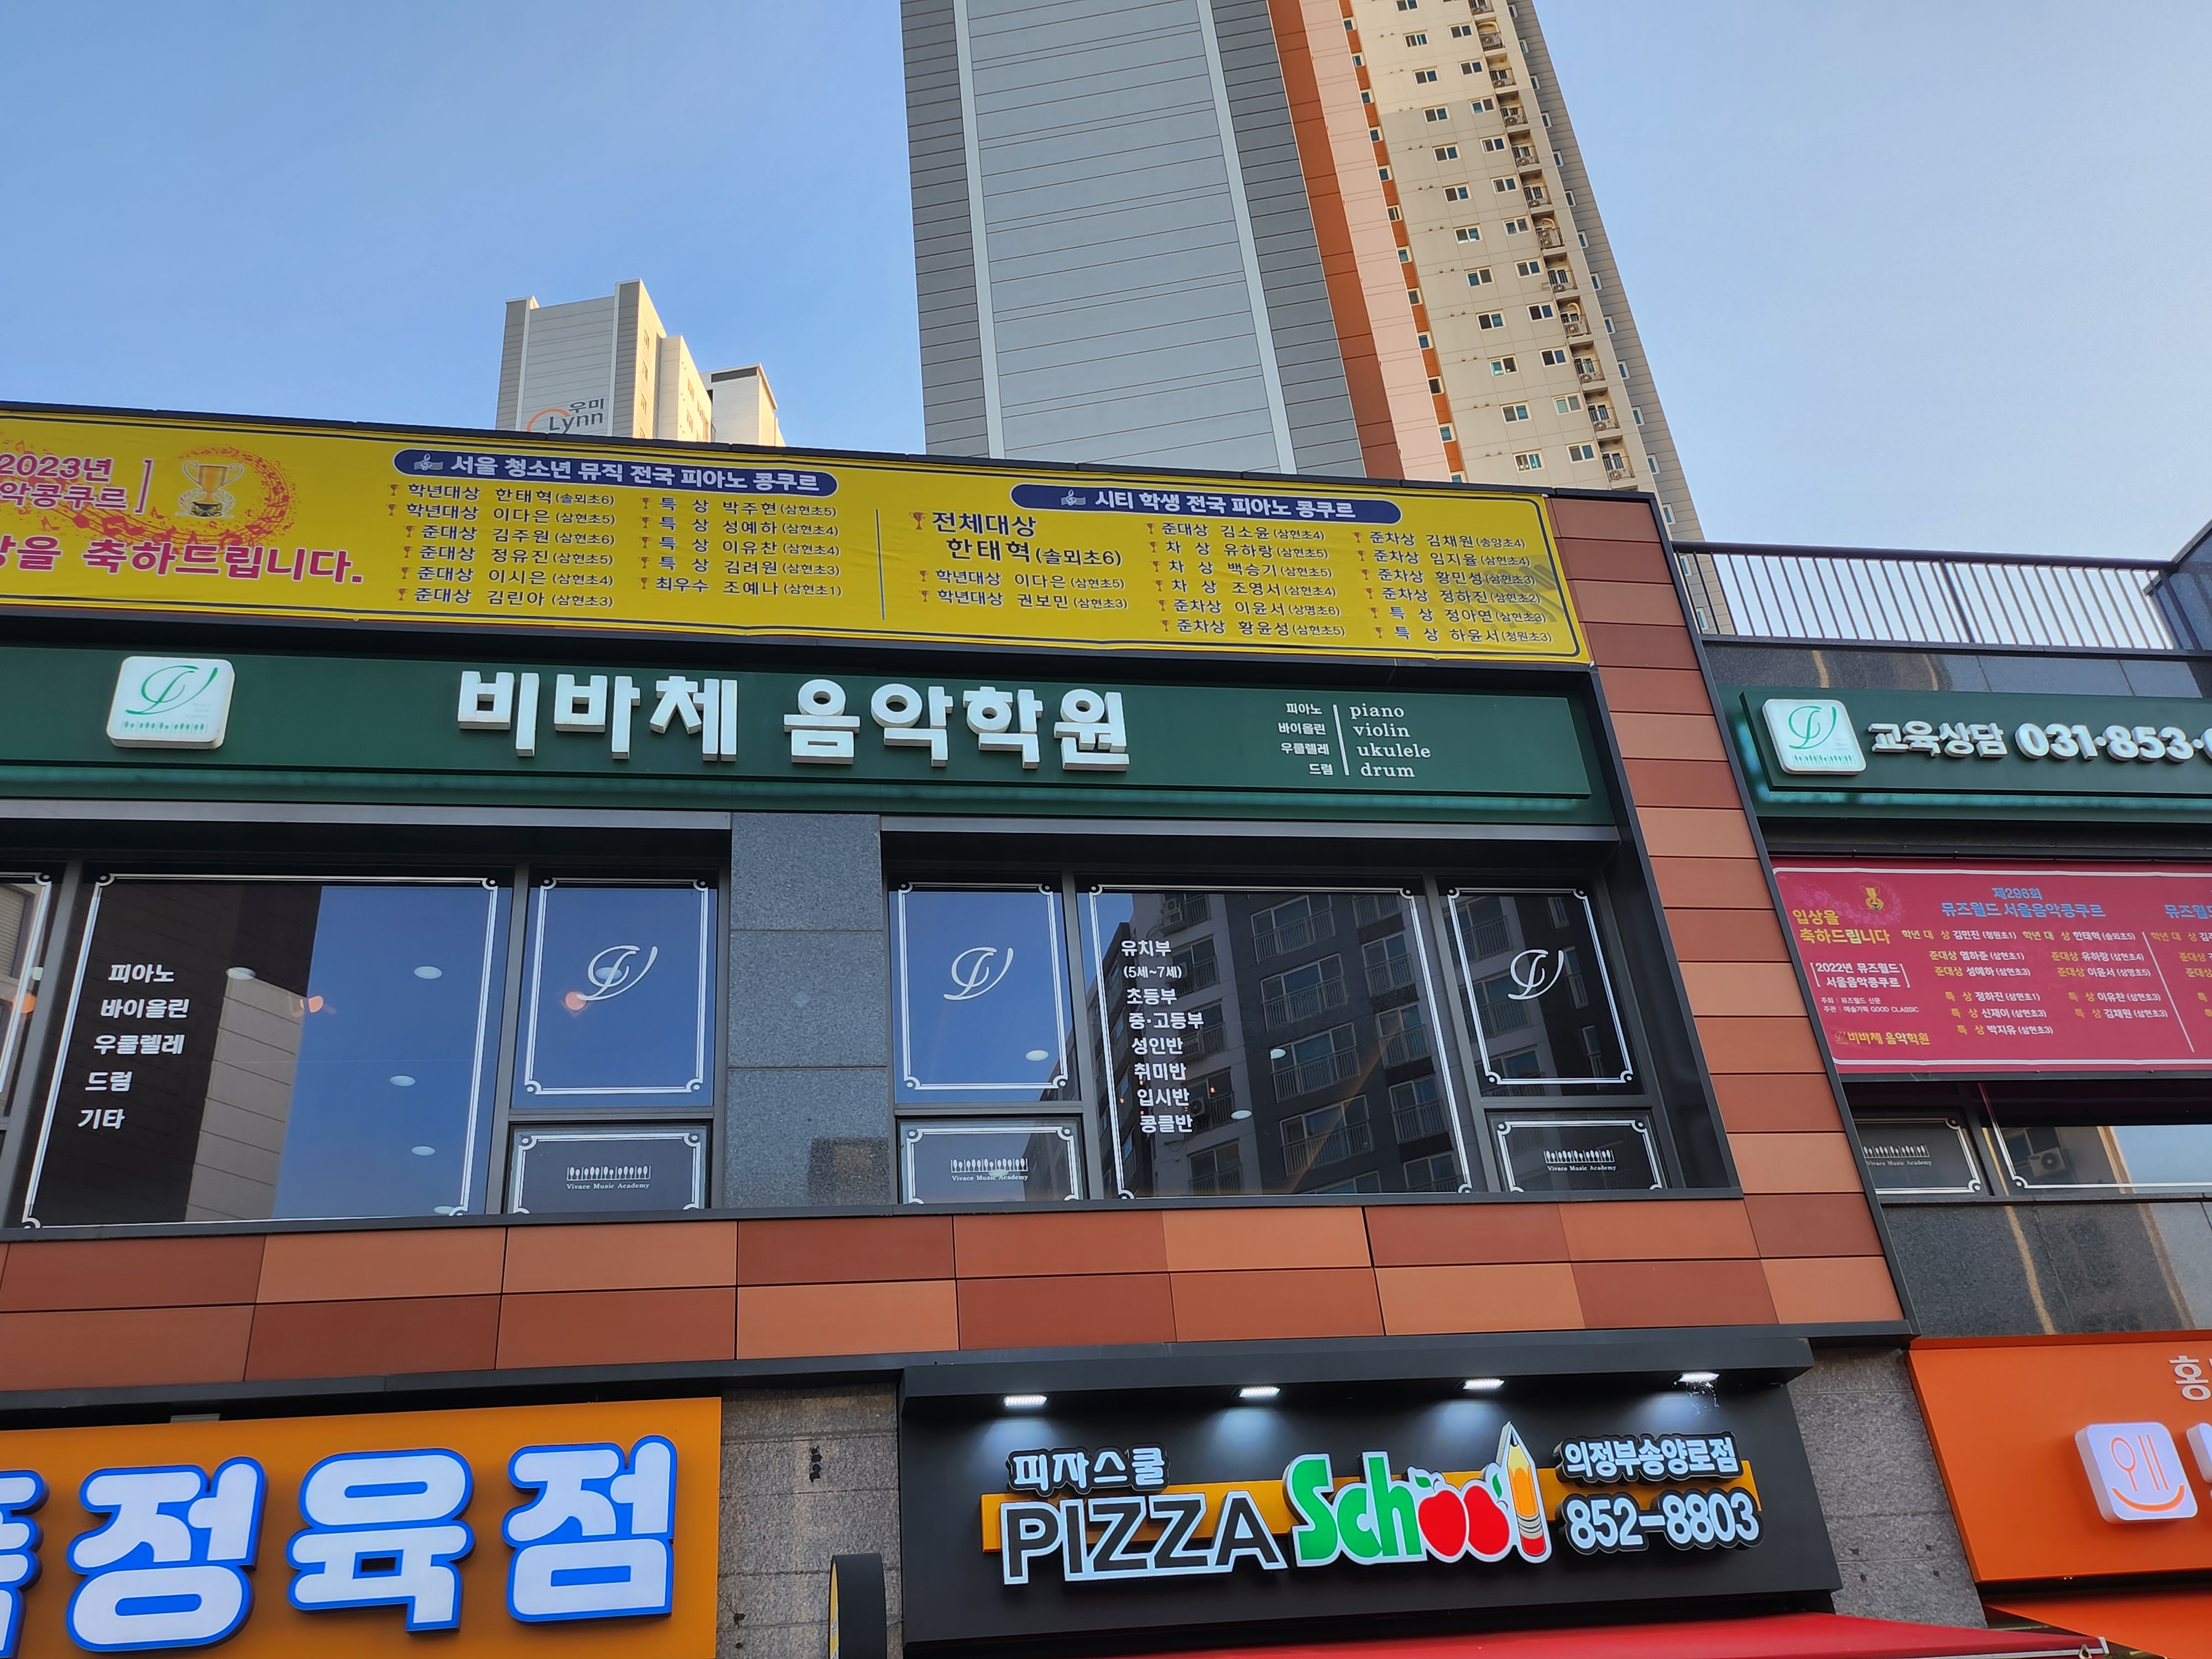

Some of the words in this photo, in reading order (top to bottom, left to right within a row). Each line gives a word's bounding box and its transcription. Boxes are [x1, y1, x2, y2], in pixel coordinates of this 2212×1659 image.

[569, 398, 604, 413] 우미
[550, 413, 603, 434] Lynn
[0, 453, 112, 482] 2023년
[451, 455, 498, 475] 서울
[504, 457, 571, 479] 청소년
[578, 462, 623, 482] 뮤직
[630, 466, 675, 485] 전국
[681, 469, 748, 489] 피아노
[753, 473, 820, 492] 콩쿠르
[408, 483, 481, 501] 학년대상
[495, 488, 552, 505] 한태혁
[406, 503, 479, 520] 학년대상
[493, 508, 550, 524] 이다은
[1095, 491, 1134, 509] 시티
[1139, 492, 1180, 512] 학생
[1186, 495, 1227, 514] 전국
[1231, 498, 1292, 516] 피아노
[1295, 501, 1356, 519] 콩쿠르
[932, 512, 1036, 537] 전체대상
[1162, 522, 1208, 538] 준대상
[1221, 525, 1270, 540] 김소윤
[421, 525, 478, 541] 준대상
[493, 528, 550, 544] 김주원
[1370, 531, 1415, 546] 준차상
[1426, 534, 1474, 549] 김채원
[419, 546, 476, 561] 준대상
[491, 549, 549, 565] 정유진
[946, 538, 1031, 563] 한태혁
[1374, 550, 1419, 565] 준차상
[1430, 552, 1478, 567] 임지율
[82, 539, 363, 584] 축하드립니다.
[417, 566, 474, 582] 준대상
[489, 570, 547, 585] 이시은
[935, 570, 1001, 586] 학년대상
[1015, 573, 1066, 589] 이다은
[656, 577, 709, 593] 최우수
[723, 581, 779, 596] 조예나
[414, 588, 472, 604] 준대상
[487, 591, 545, 606] 김린아
[937, 589, 1004, 606] 학년대상
[1016, 594, 1069, 609] 권보민
[1173, 599, 1222, 614] 준차상
[1235, 602, 1285, 616] 이윤서
[1177, 619, 1225, 635] 준차상
[1238, 621, 1289, 637] 황윤성
[1286, 703, 1322, 715] 피아노
[1349, 703, 1405, 719] piano
[457, 670, 738, 763] 비바체
[782, 678, 1130, 773] 음악학원
[1278, 722, 1326, 735] 바이올린
[1353, 722, 1410, 737] violin
[1281, 743, 1329, 755] 우쿨렐레
[1867, 721, 2007, 759] 교육상담
[1357, 743, 1431, 758] ukulele
[1310, 764, 1333, 775] 드럼
[1360, 763, 1415, 778] drum
[1992, 888, 2043, 900] 제296회
[1792, 910, 1839, 925] 입상을
[1942, 902, 2002, 917] 뮤즈월드
[2004, 903, 2106, 918] 서울음악콩쿠르
[1800, 928, 1890, 944] 축하드립니다
[1121, 940, 1171, 957] 유치부
[1929, 951, 1957, 961] 준대상
[2051, 952, 2079, 962] 준대상
[108, 964, 174, 983] 피아노
[1815, 962, 1854, 974] 2022년
[1857, 963, 1900, 974] 뮤즈월드
[1935, 967, 1963, 976] 준대상
[2057, 968, 2085, 977] 준대상
[1827, 977, 1901, 988] 서울음악콩쿠르
[1126, 988, 1177, 1005] 초등부
[101, 999, 190, 1019] 바이올린
[93, 1034, 185, 1055] 우쿨렐레
[1131, 1037, 1183, 1055] 성인반
[1847, 1032, 1884, 1045] 비바체
[1885, 1032, 1931, 1045] 음악학원
[1134, 1062, 1187, 1081] 취미반
[85, 1071, 133, 1092] 드럼
[1137, 1088, 1190, 1107] 입시반
[77, 1109, 126, 1129] 기타
[1140, 1114, 1193, 1133] 콩클반
[1565, 1434, 1738, 1480] 의정부송양로점
[1014, 1449, 1167, 1492] 피자스쿨
[1563, 1495, 1760, 1550] 852-8803
[1003, 1492, 1287, 1584] PIZZA
